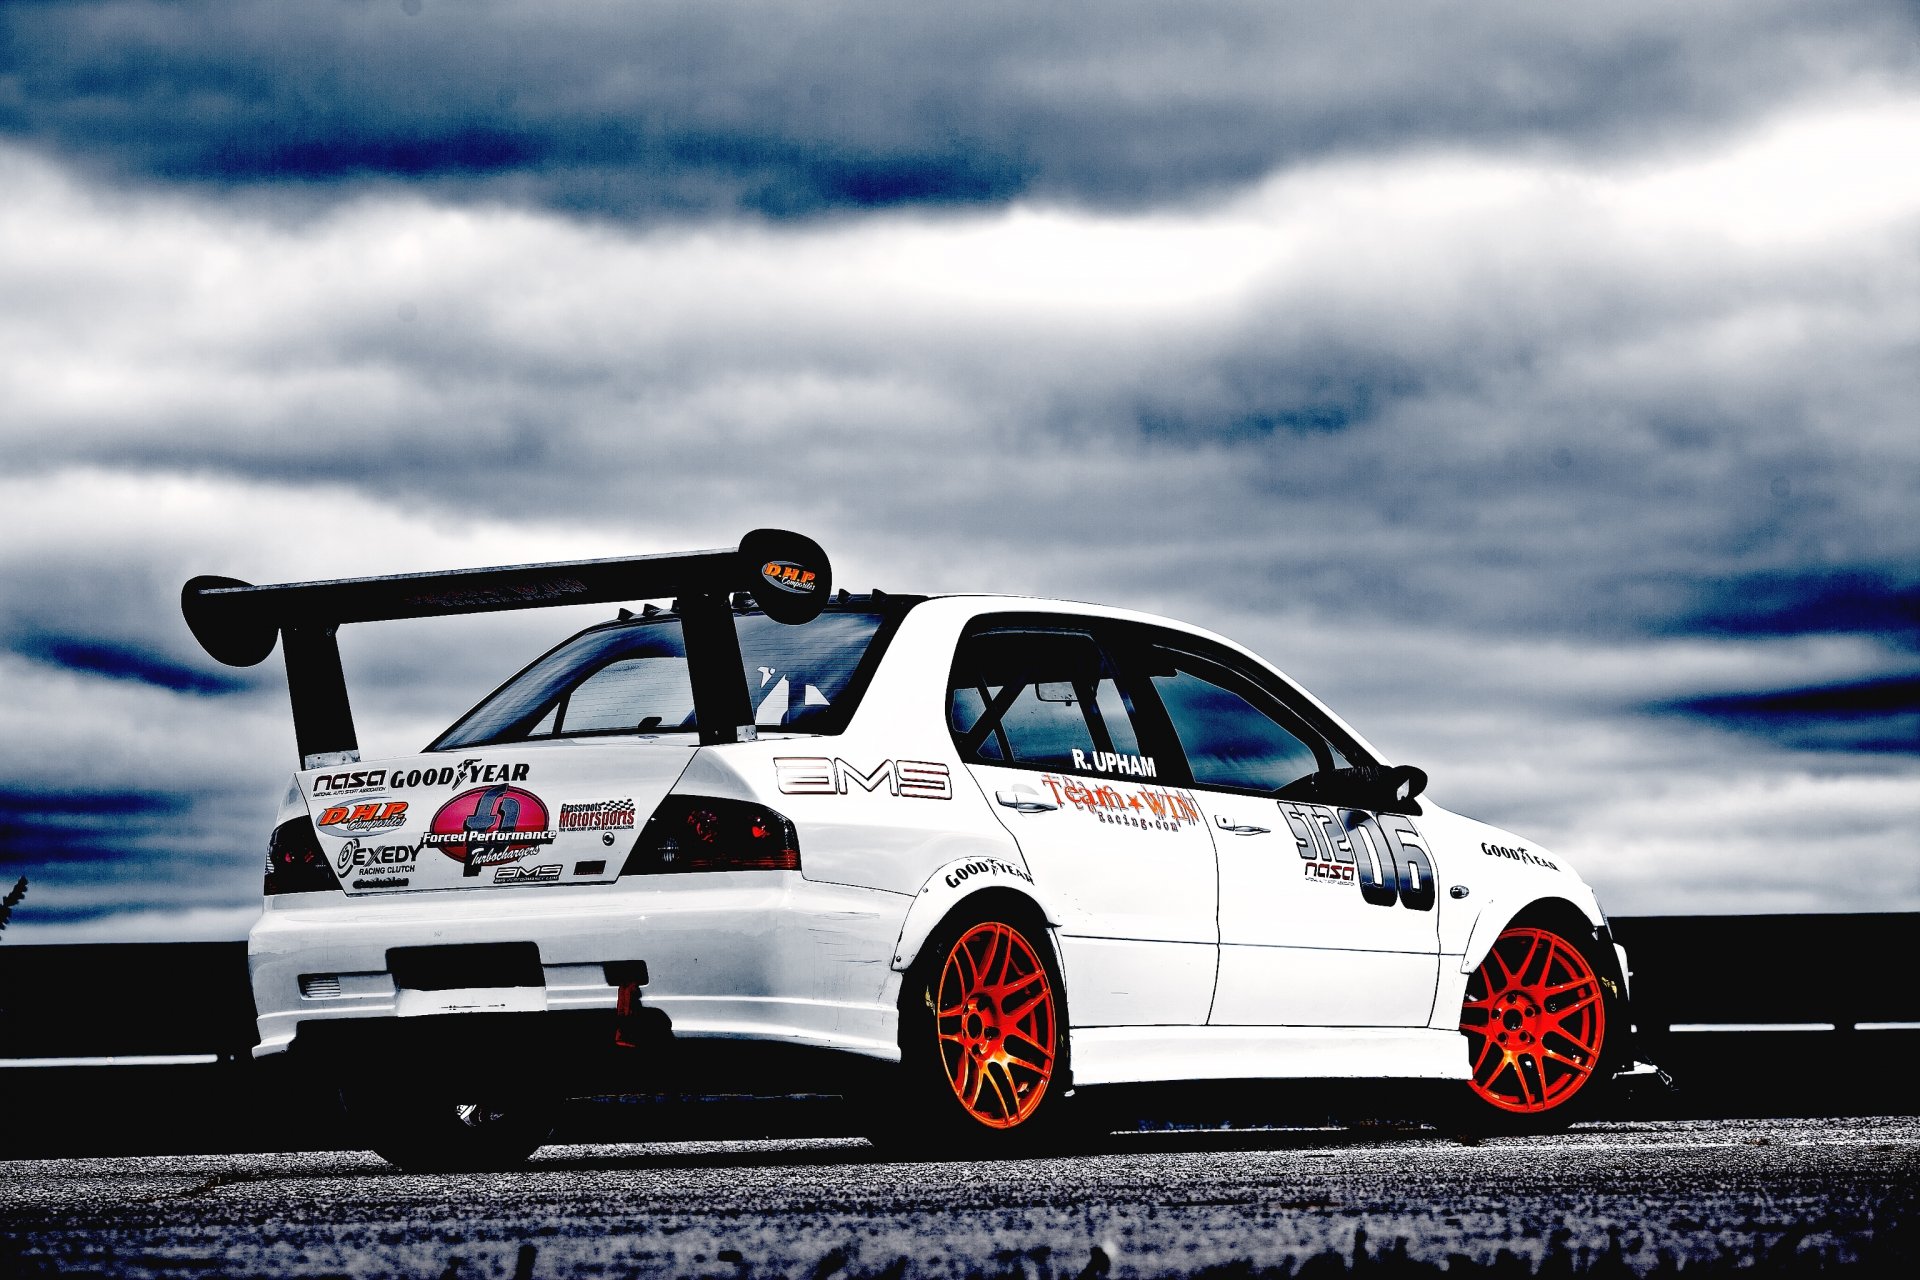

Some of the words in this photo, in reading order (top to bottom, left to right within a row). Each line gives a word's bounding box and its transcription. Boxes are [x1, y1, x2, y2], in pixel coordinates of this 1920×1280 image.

[764, 563, 815, 585] D.H.P.
[781, 577, 816, 591] Composites
[1072, 748, 1092, 771] R.
[1093, 751, 1157, 778] UPHAM
[319, 801, 409, 826] D.H.P.
[561, 803, 602, 812] Grassroots
[347, 817, 407, 831] Composites
[558, 810, 635, 831] Motorsports
[422, 831, 467, 843] Forced
[468, 830, 557, 842] Performance
[353, 843, 422, 867] EXEDY
[471, 845, 541, 866] Turbochargers
[1337, 807, 1436, 911] 06
[359, 867, 385, 875] RACING
[387, 865, 415, 874] CLUTCH
